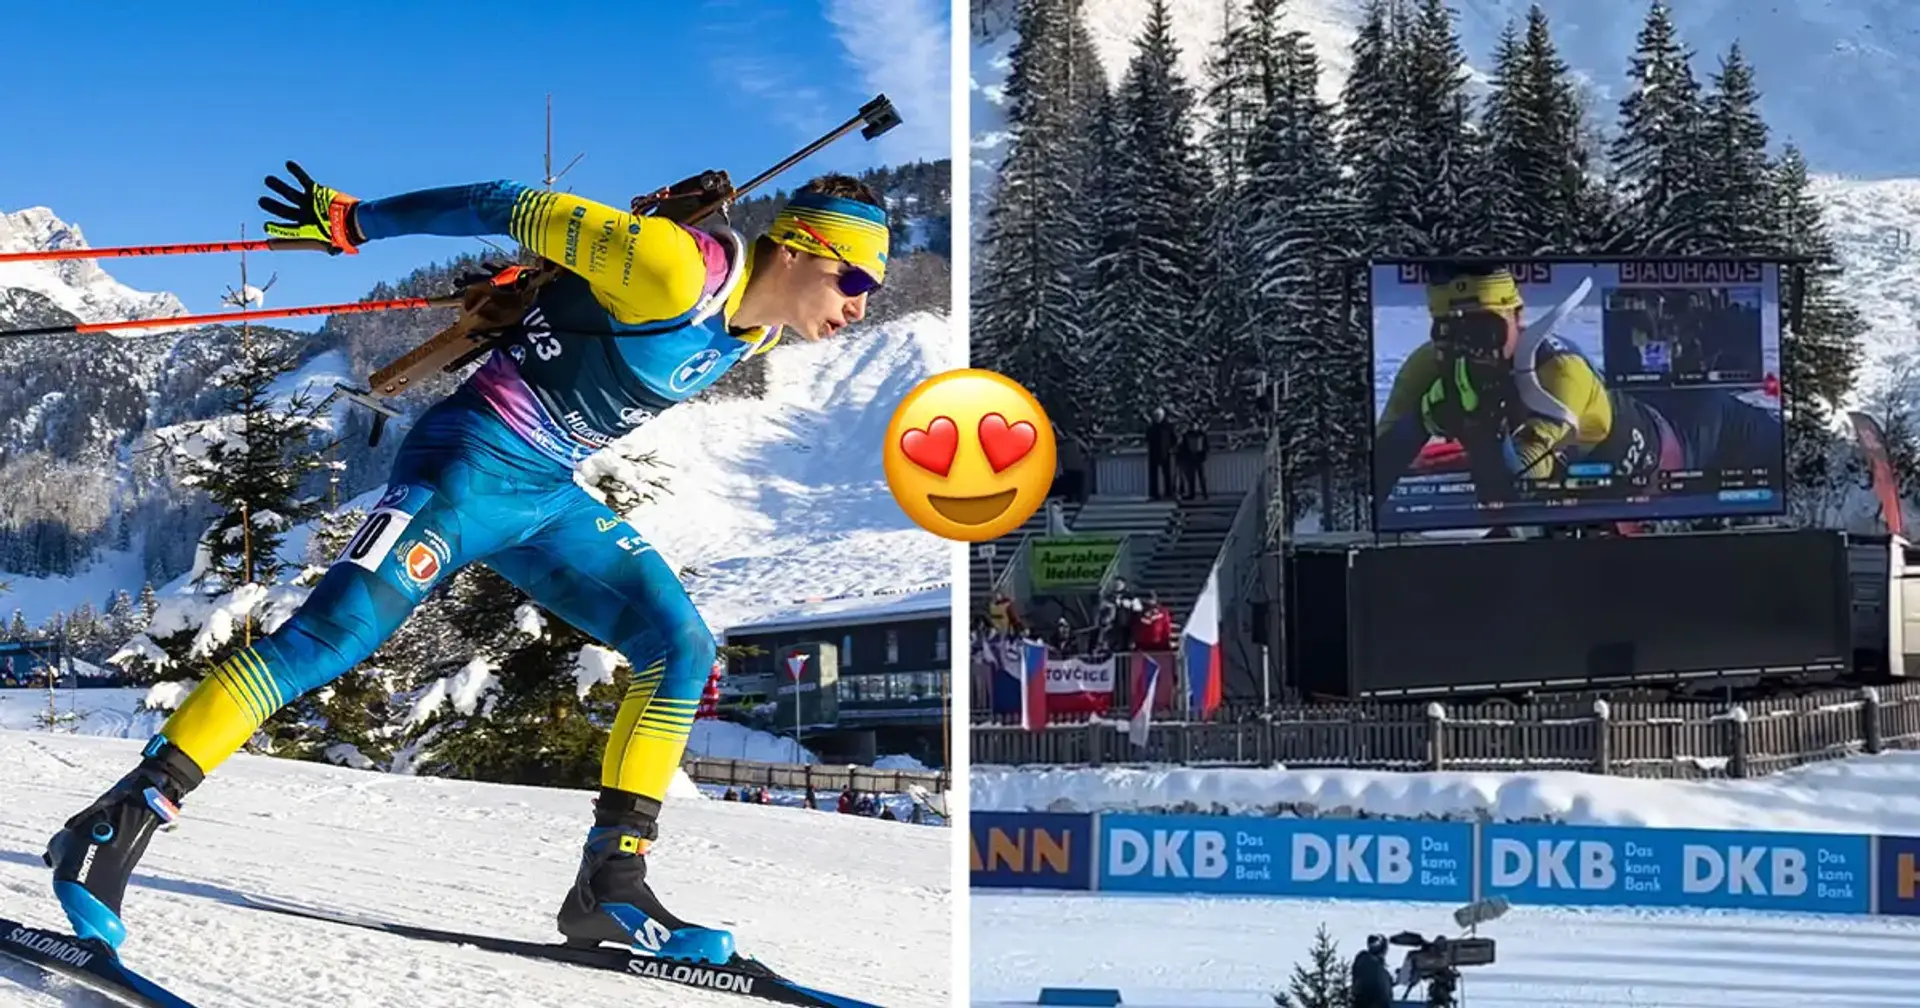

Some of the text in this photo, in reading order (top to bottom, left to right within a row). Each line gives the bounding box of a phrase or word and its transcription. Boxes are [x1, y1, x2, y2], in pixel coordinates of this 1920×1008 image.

[1236, 831, 1264, 847] Das
[1422, 837, 1449, 853] Das
[1109, 828, 1228, 879] DKB
[1235, 848, 1271, 864] kann
[1291, 832, 1413, 884] DKB
[1625, 841, 1653, 858] Das
[1818, 848, 1846, 865] Das
[1422, 853, 1457, 870] kann
[1491, 838, 1616, 890] DKB
[1625, 858, 1661, 875] kann
[1683, 844, 1808, 896] DKB
[1236, 865, 1271, 881] Bank
[1421, 870, 1458, 887] Bank
[1818, 867, 1854, 882] kann
[1625, 876, 1661, 892] Bank
[1818, 883, 1854, 899] Bank
[6, 927, 94, 968] SALOMON
[625, 958, 755, 994] SALOMON
